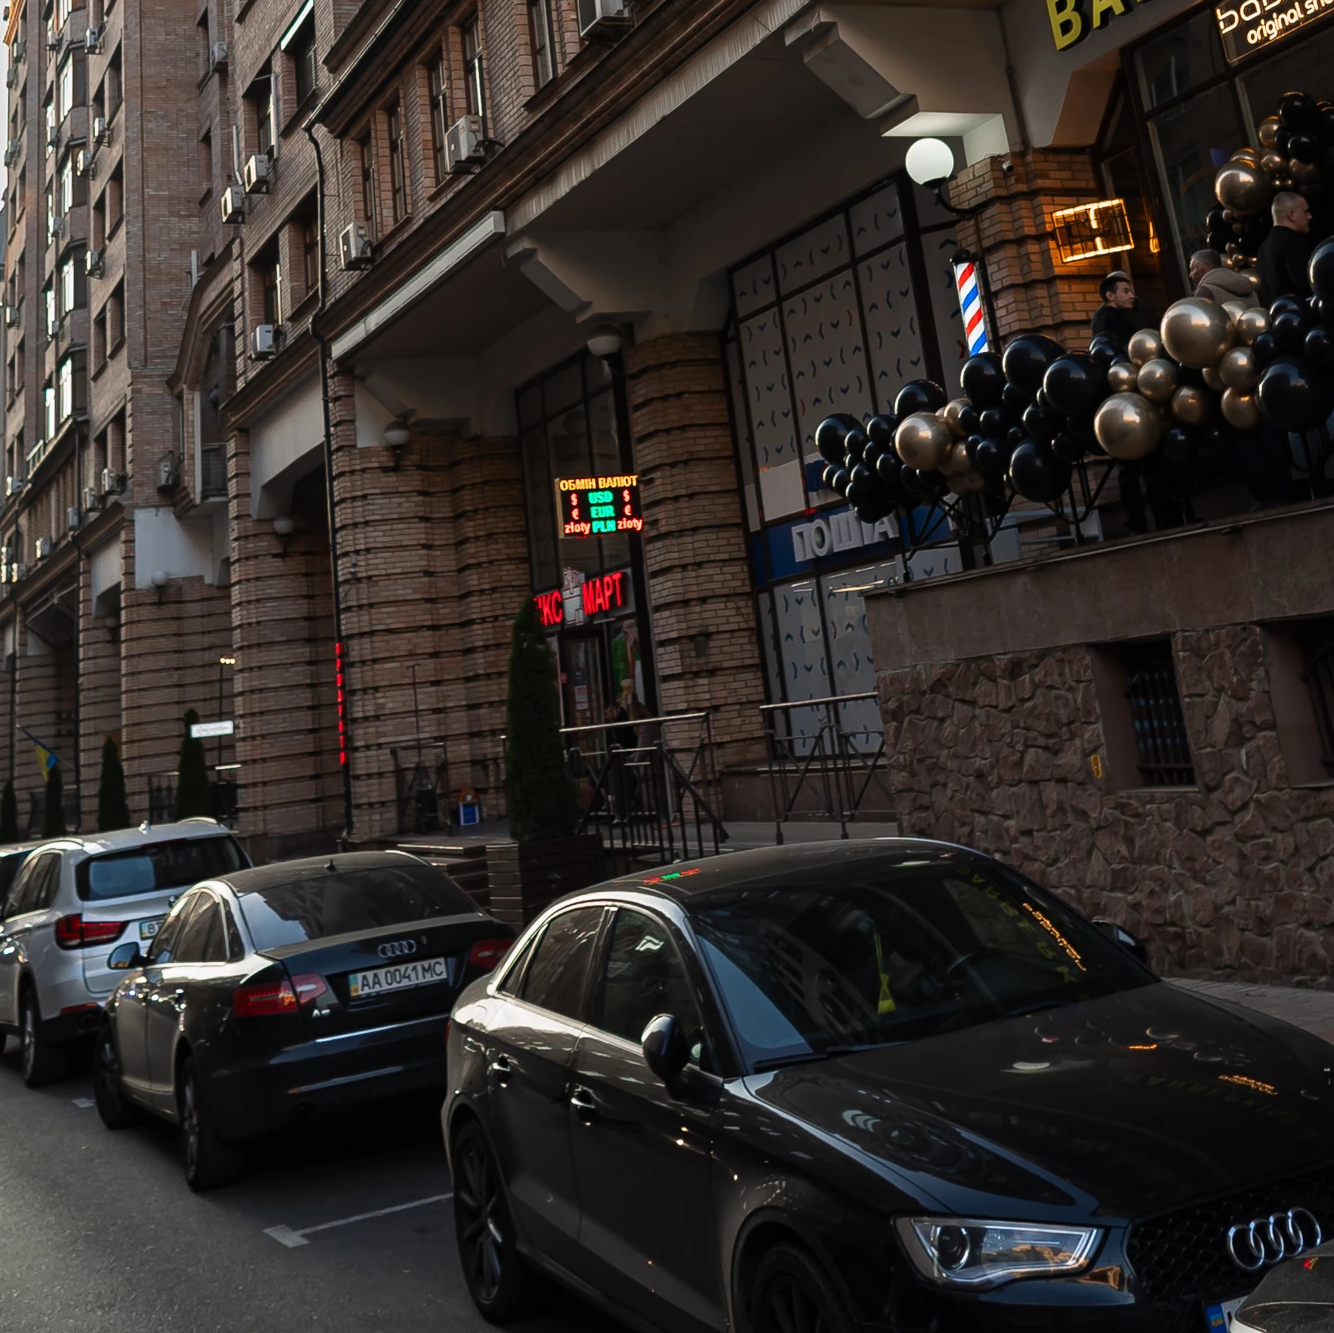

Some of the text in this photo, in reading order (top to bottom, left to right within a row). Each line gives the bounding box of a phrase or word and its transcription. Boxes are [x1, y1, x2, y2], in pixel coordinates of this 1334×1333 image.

[1246, 2, 1304, 44] original
[559, 478, 597, 491] ОБМІН
[588, 491, 613, 504] USD
[590, 505, 615, 518] EUR
[591, 520, 616, 533] PLN
[582, 571, 623, 616] МАРТ
[360, 961, 445, 992] AA 0041 MC
